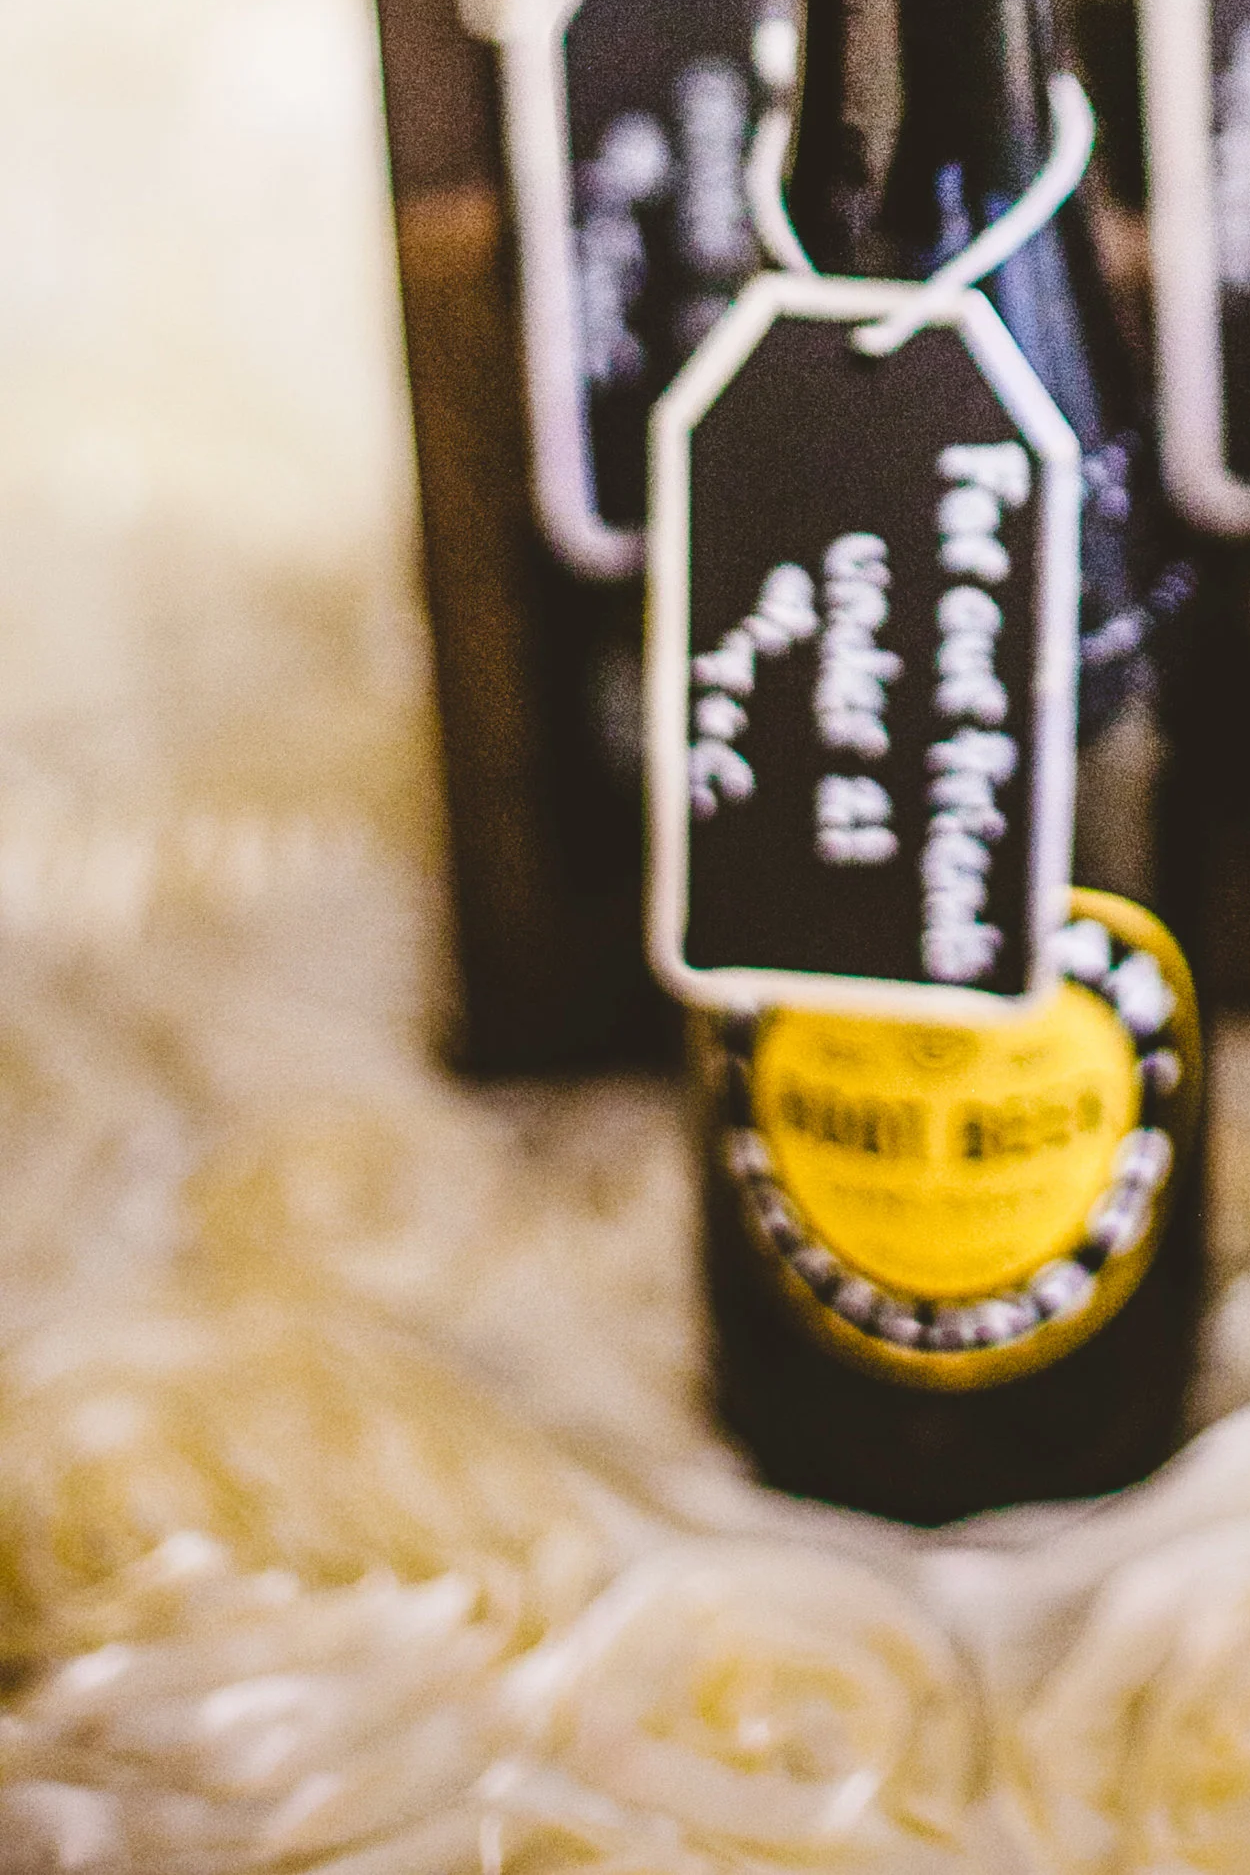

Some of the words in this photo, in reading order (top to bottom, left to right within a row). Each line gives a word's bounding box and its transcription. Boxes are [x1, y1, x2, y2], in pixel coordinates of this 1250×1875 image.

[938, 441, 1031, 582] For
[814, 532, 902, 759] under
[936, 586, 1009, 723] our
[815, 774, 898, 864] 21
[921, 727, 1019, 981] friends
[779, 1075, 929, 1157] ROOT
